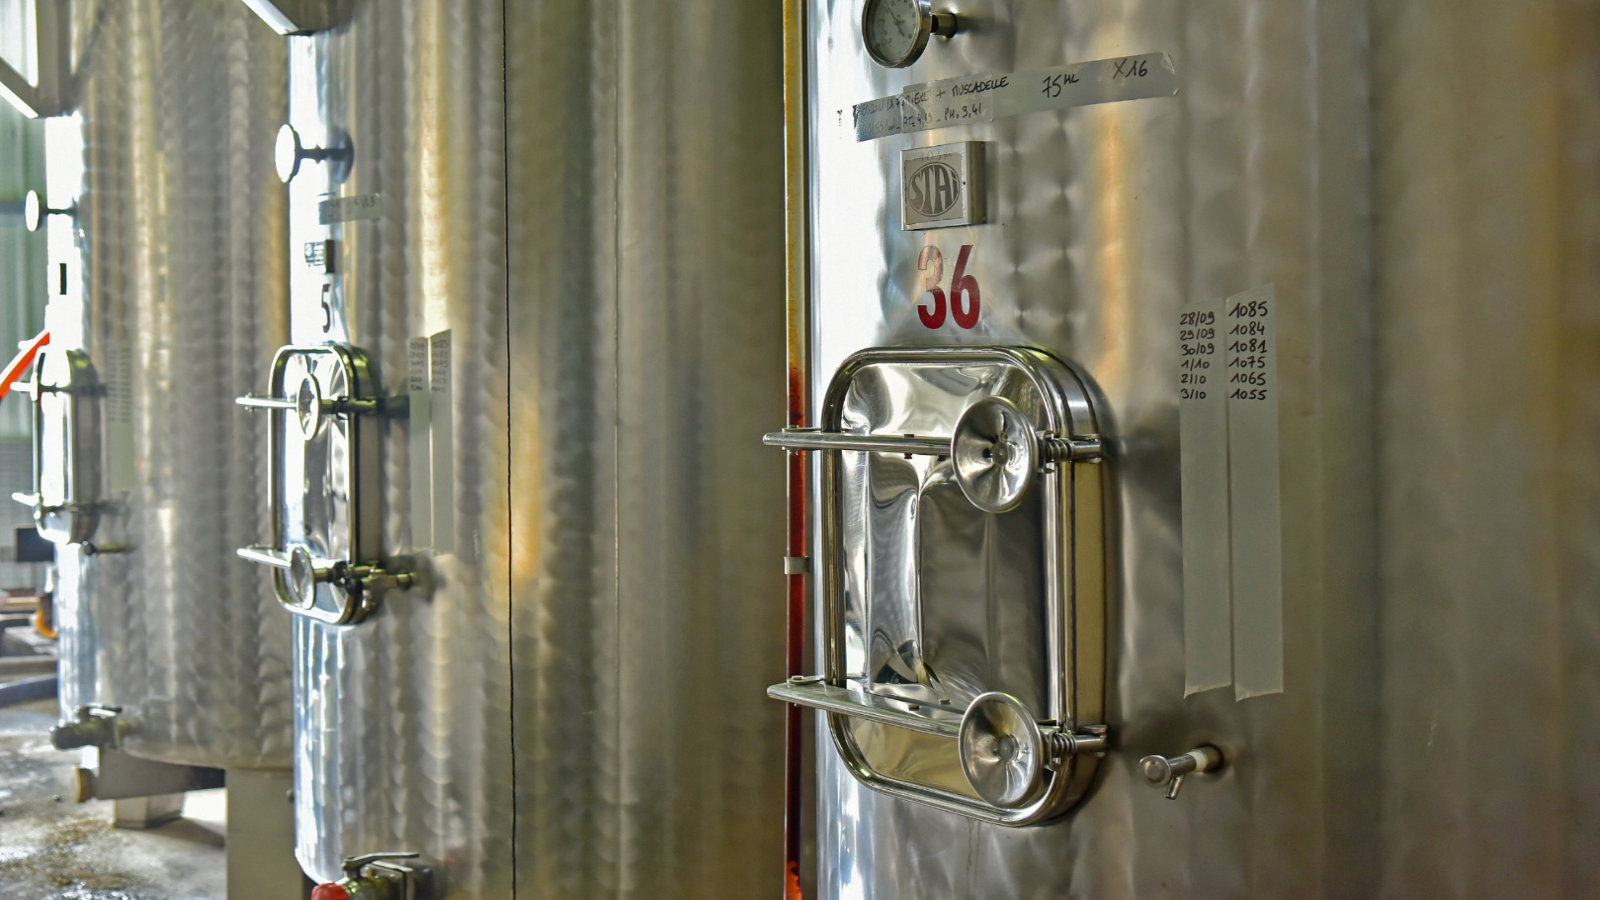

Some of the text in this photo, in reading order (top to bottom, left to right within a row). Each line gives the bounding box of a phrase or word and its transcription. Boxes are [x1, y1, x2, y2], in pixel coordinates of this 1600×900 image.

[917, 244, 981, 329] 36
[321, 283, 332, 333] 5
[1228, 300, 1268, 318] 1085
[1179, 310, 1216, 327] 28/09
[1180, 327, 1215, 341] 29/09
[1229, 321, 1265, 336] 1084
[1181, 342, 1215, 356] 30/09
[1228, 338, 1268, 354] 1081
[1180, 358, 1210, 372] 1/10
[1228, 355, 1266, 369] 1075
[1180, 373, 1207, 385] 2/10
[1230, 371, 1266, 386] 1065
[1180, 388, 1207, 400] 3/10
[1229, 388, 1268, 401] 1055
